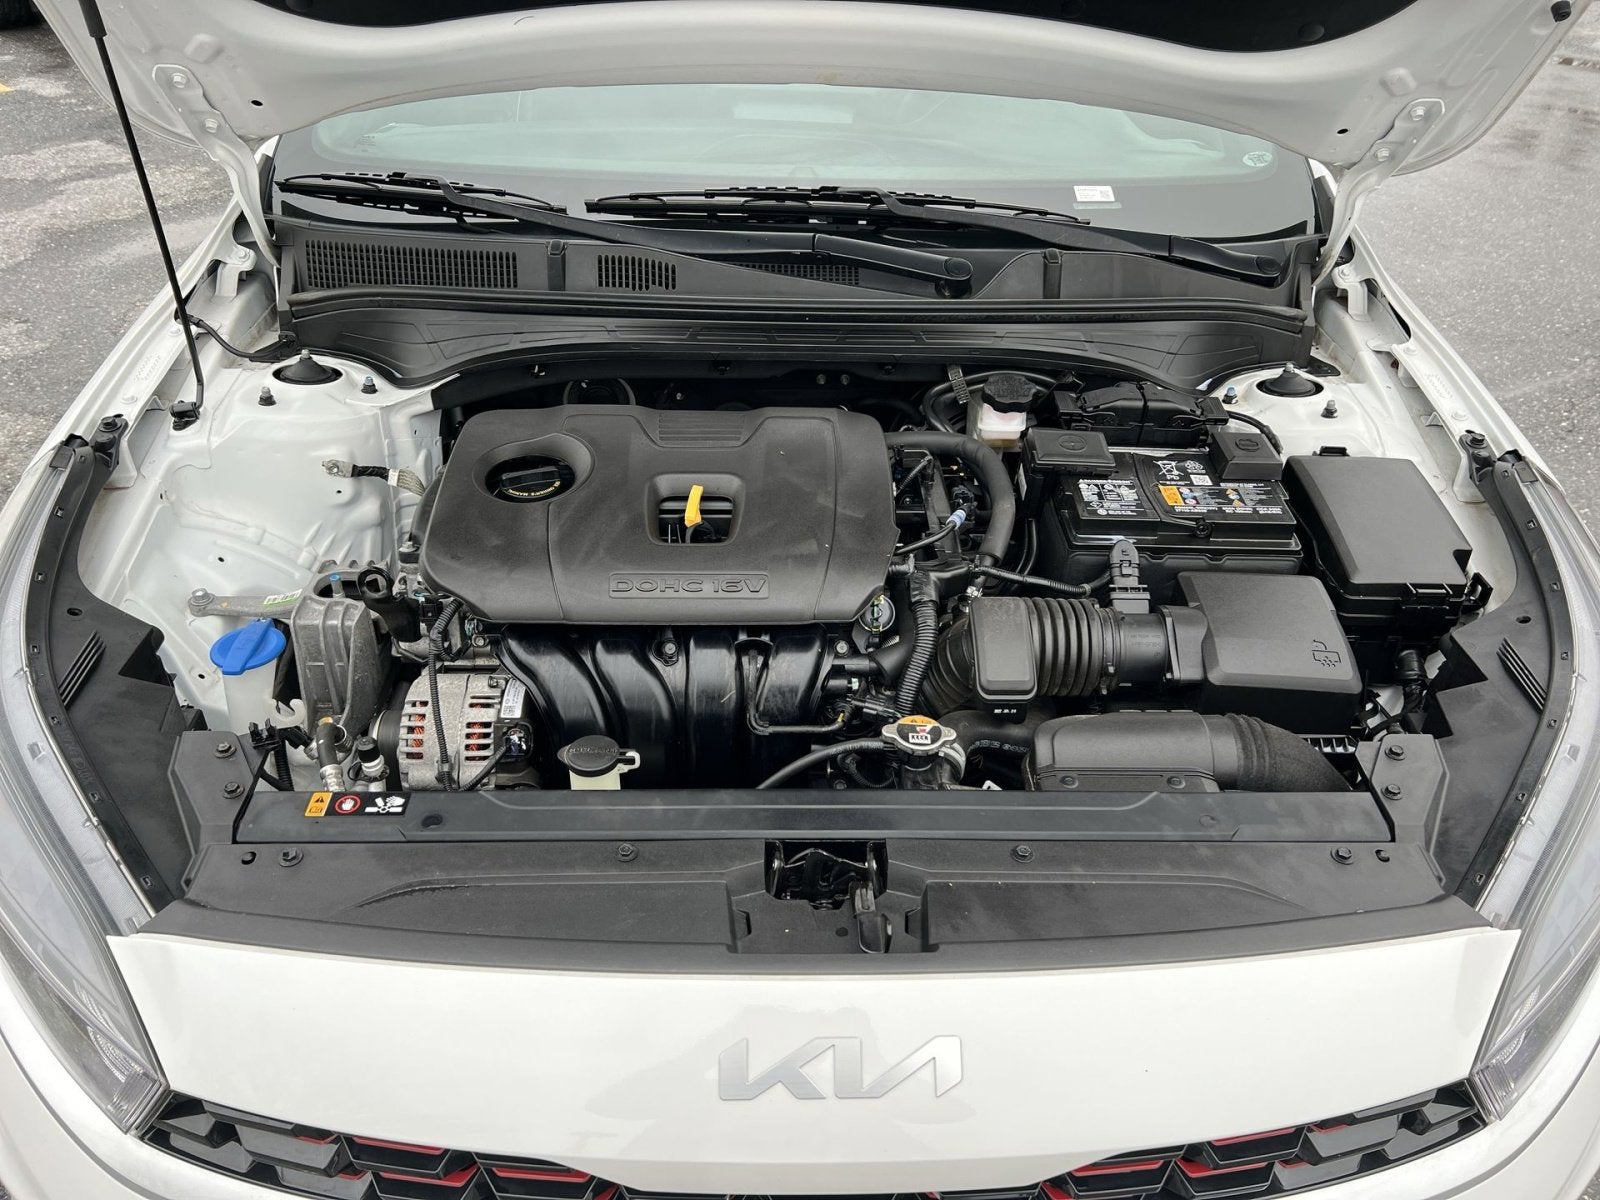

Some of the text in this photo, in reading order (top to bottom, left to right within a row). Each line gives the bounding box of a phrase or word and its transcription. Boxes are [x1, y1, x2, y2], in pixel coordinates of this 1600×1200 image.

[611, 578, 767, 593] DOHC 16V
[718, 1035, 963, 1101] KIA
